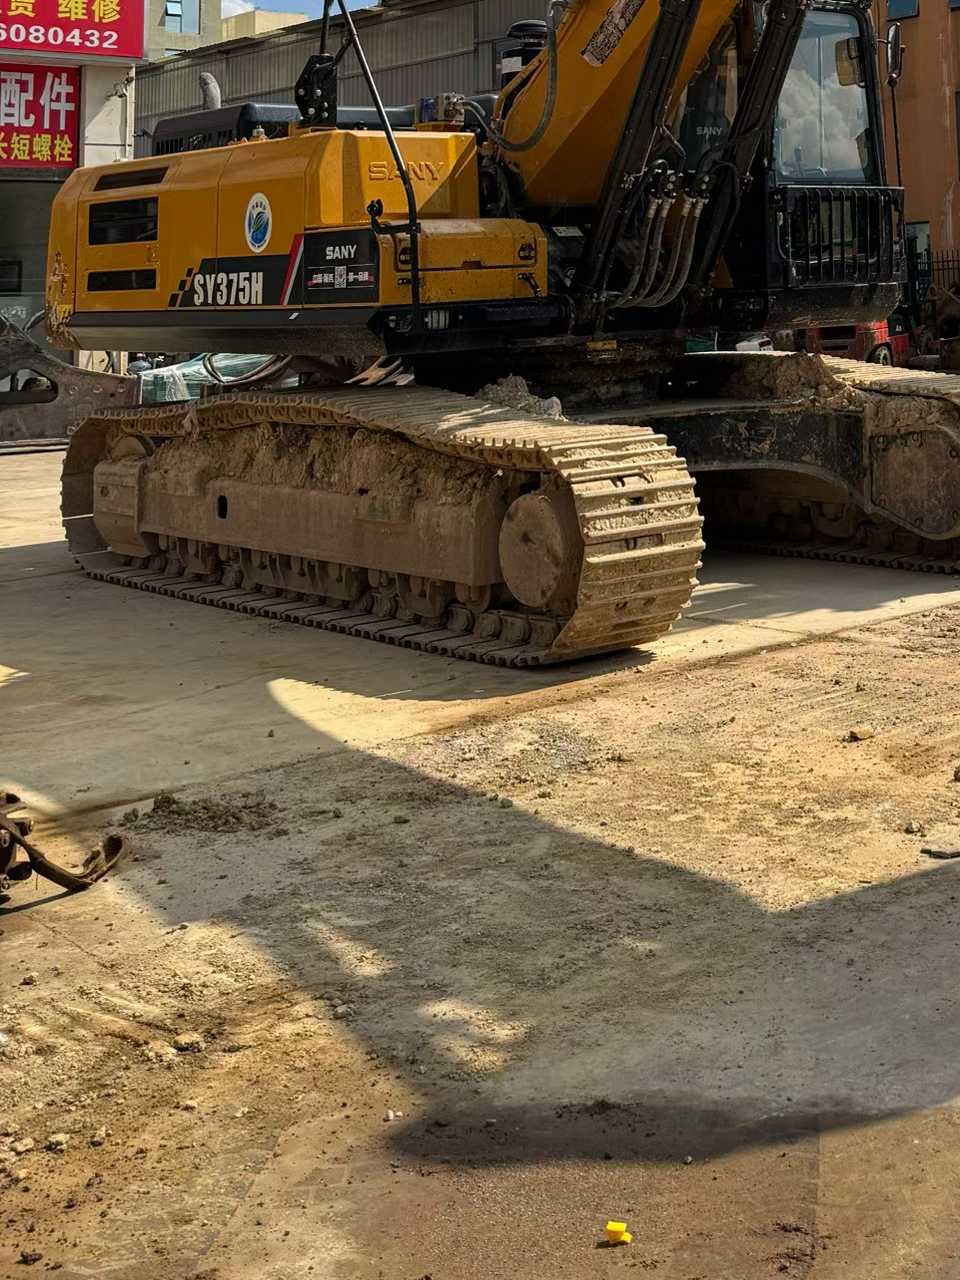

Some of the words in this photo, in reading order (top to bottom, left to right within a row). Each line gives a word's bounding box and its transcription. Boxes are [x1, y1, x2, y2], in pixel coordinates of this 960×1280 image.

[0, 71, 76, 131] 配件
[325, 244, 357, 260] SANY
[193, 271, 264, 306] SY375H
